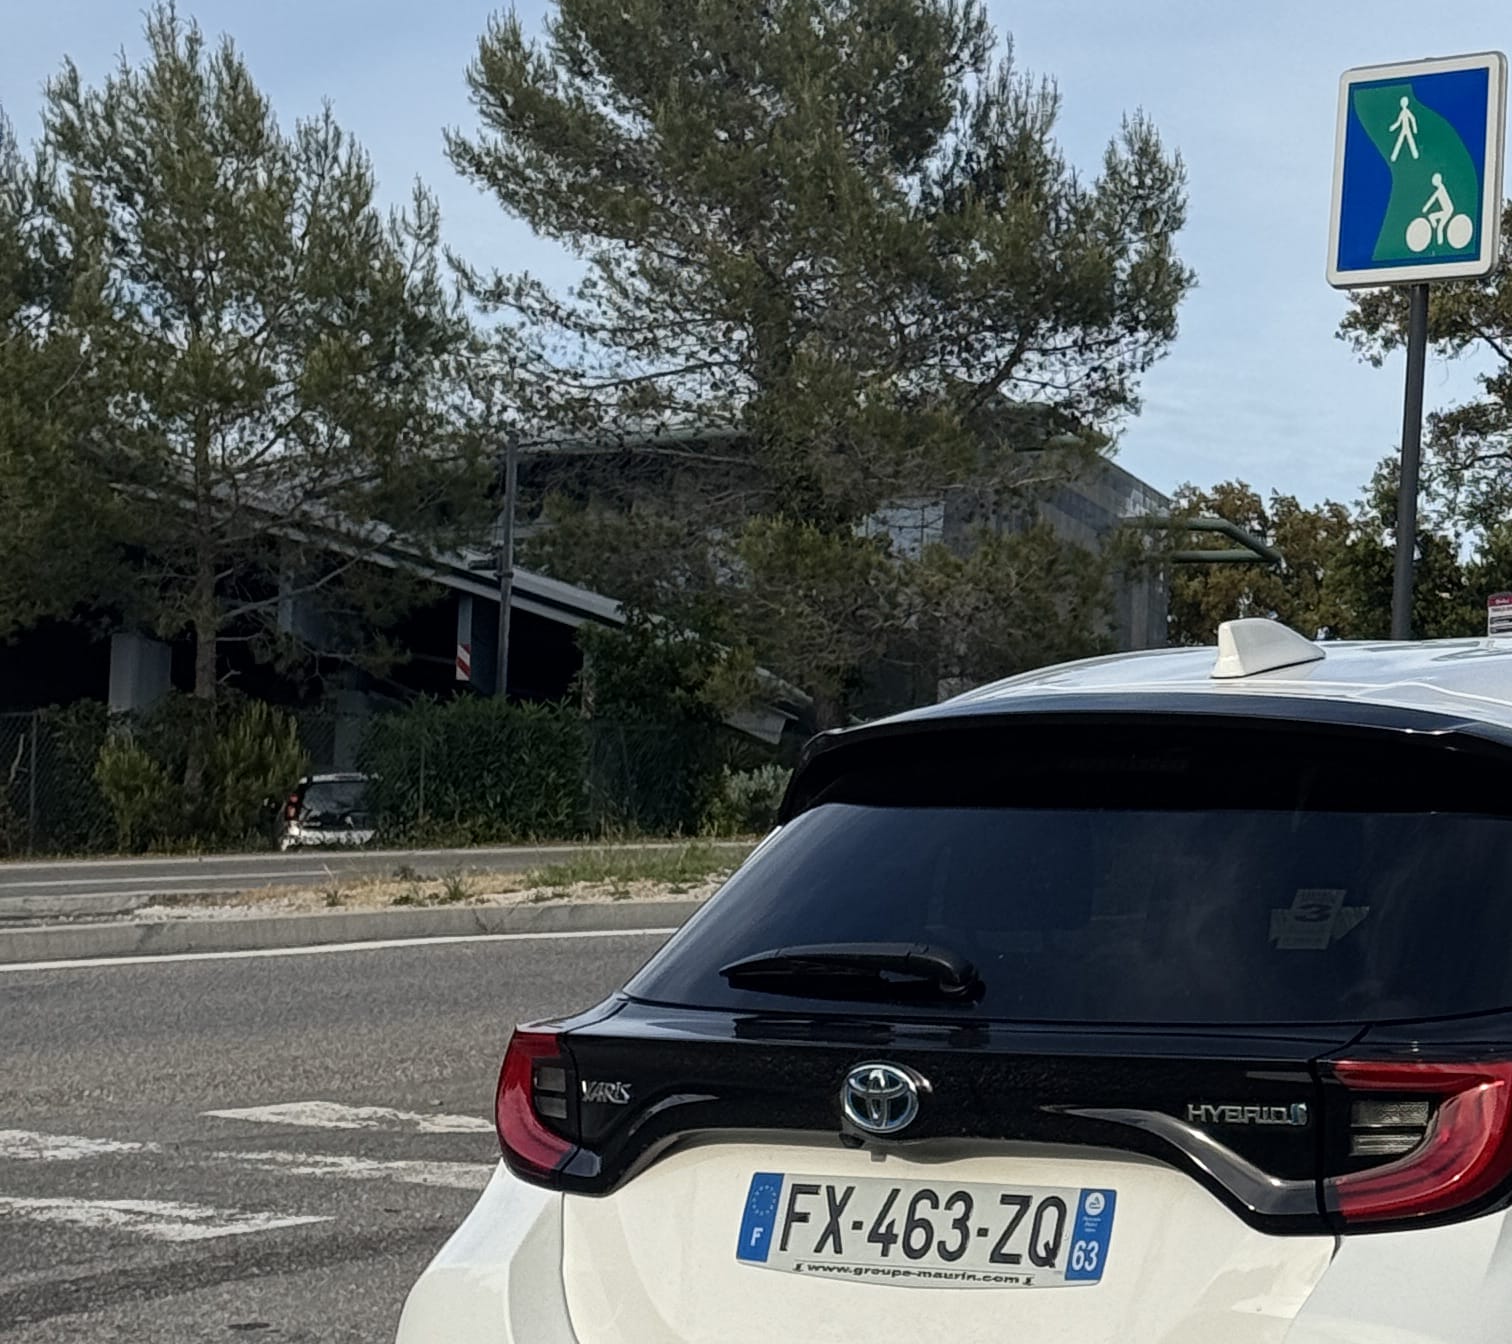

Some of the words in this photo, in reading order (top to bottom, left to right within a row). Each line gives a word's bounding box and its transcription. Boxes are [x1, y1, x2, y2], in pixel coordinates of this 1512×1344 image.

[1187, 1104, 1288, 1124] HYBRID
[750, 1227, 764, 1247] F
[779, 1183, 1067, 1268] FX-463-ZQ
[1072, 1240, 1100, 1272] 63
[807, 1262, 1019, 1285] www.groupe-maurin.com
